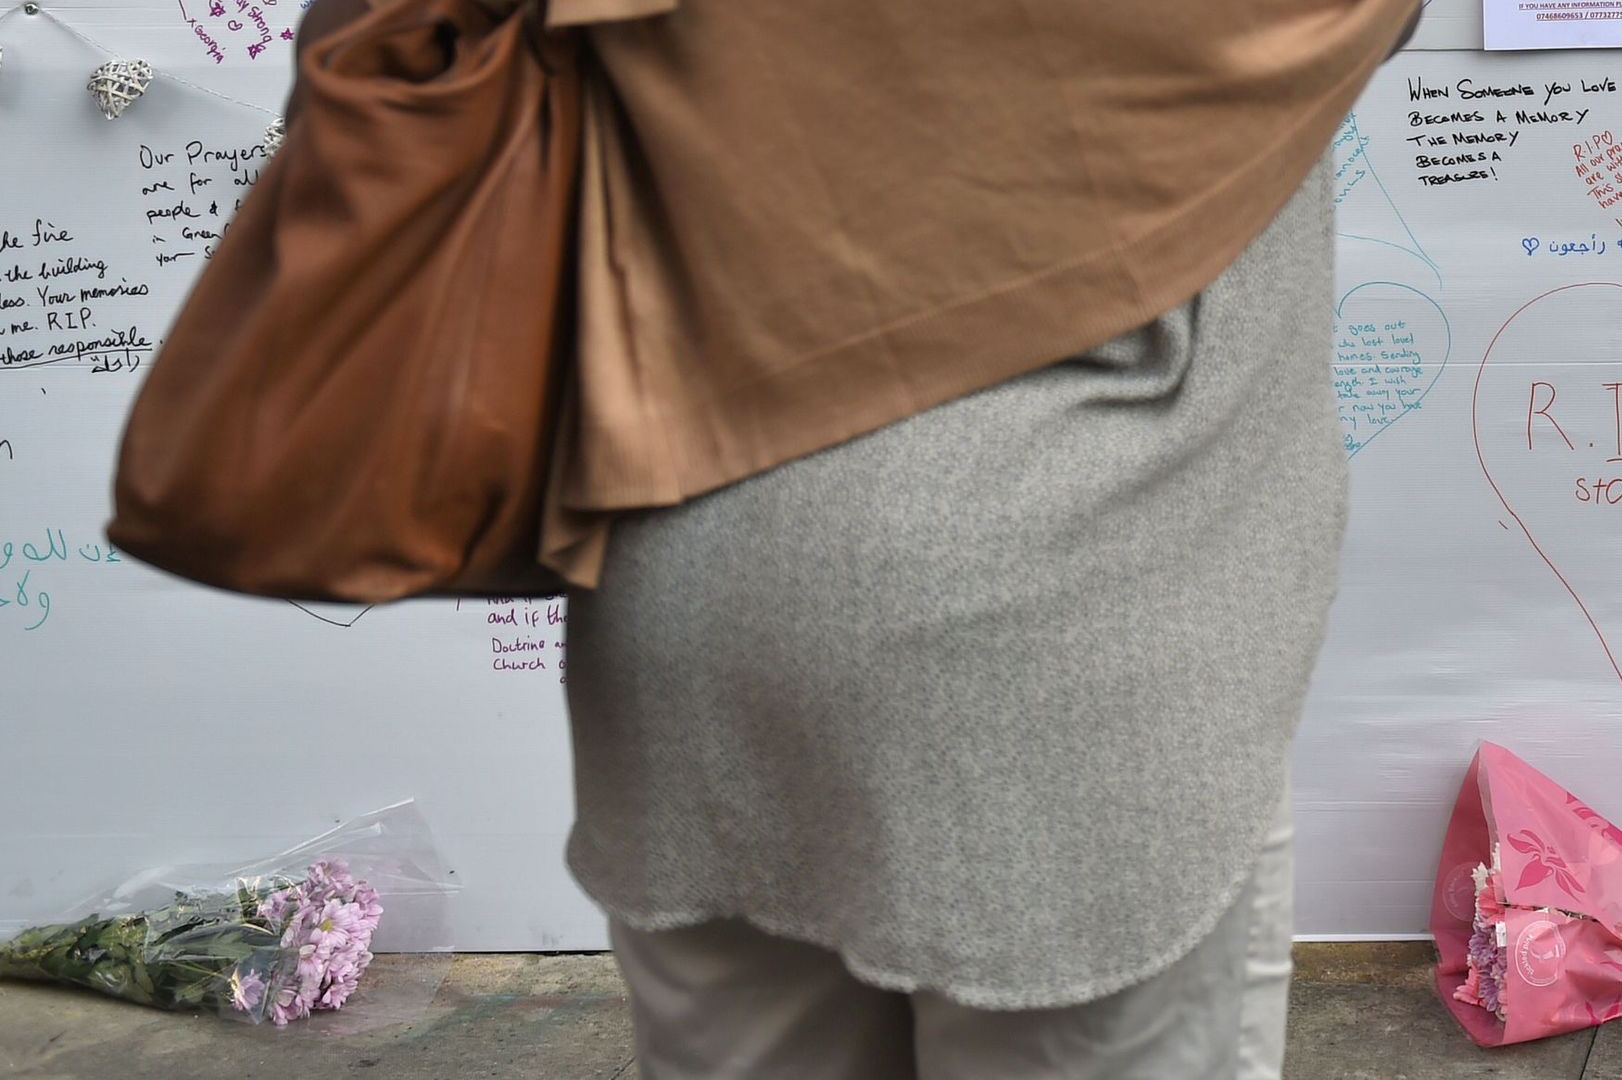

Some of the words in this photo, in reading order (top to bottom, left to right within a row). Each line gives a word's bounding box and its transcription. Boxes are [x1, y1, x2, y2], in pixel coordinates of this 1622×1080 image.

[1408, 76, 1449, 102] WHEN
[1456, 78, 1535, 100] SOMEONE
[1544, 82, 1571, 106] YOU
[1581, 77, 1617, 93] LOVE
[1408, 110, 1485, 127] BECOMES
[1496, 109, 1508, 123] A
[1515, 108, 1590, 125] MEMORY
[1406, 134, 1448, 148] THE
[1453, 130, 1520, 147] MEMORY
[1416, 152, 1487, 168] BECOMES
[1492, 151, 1502, 162] A
